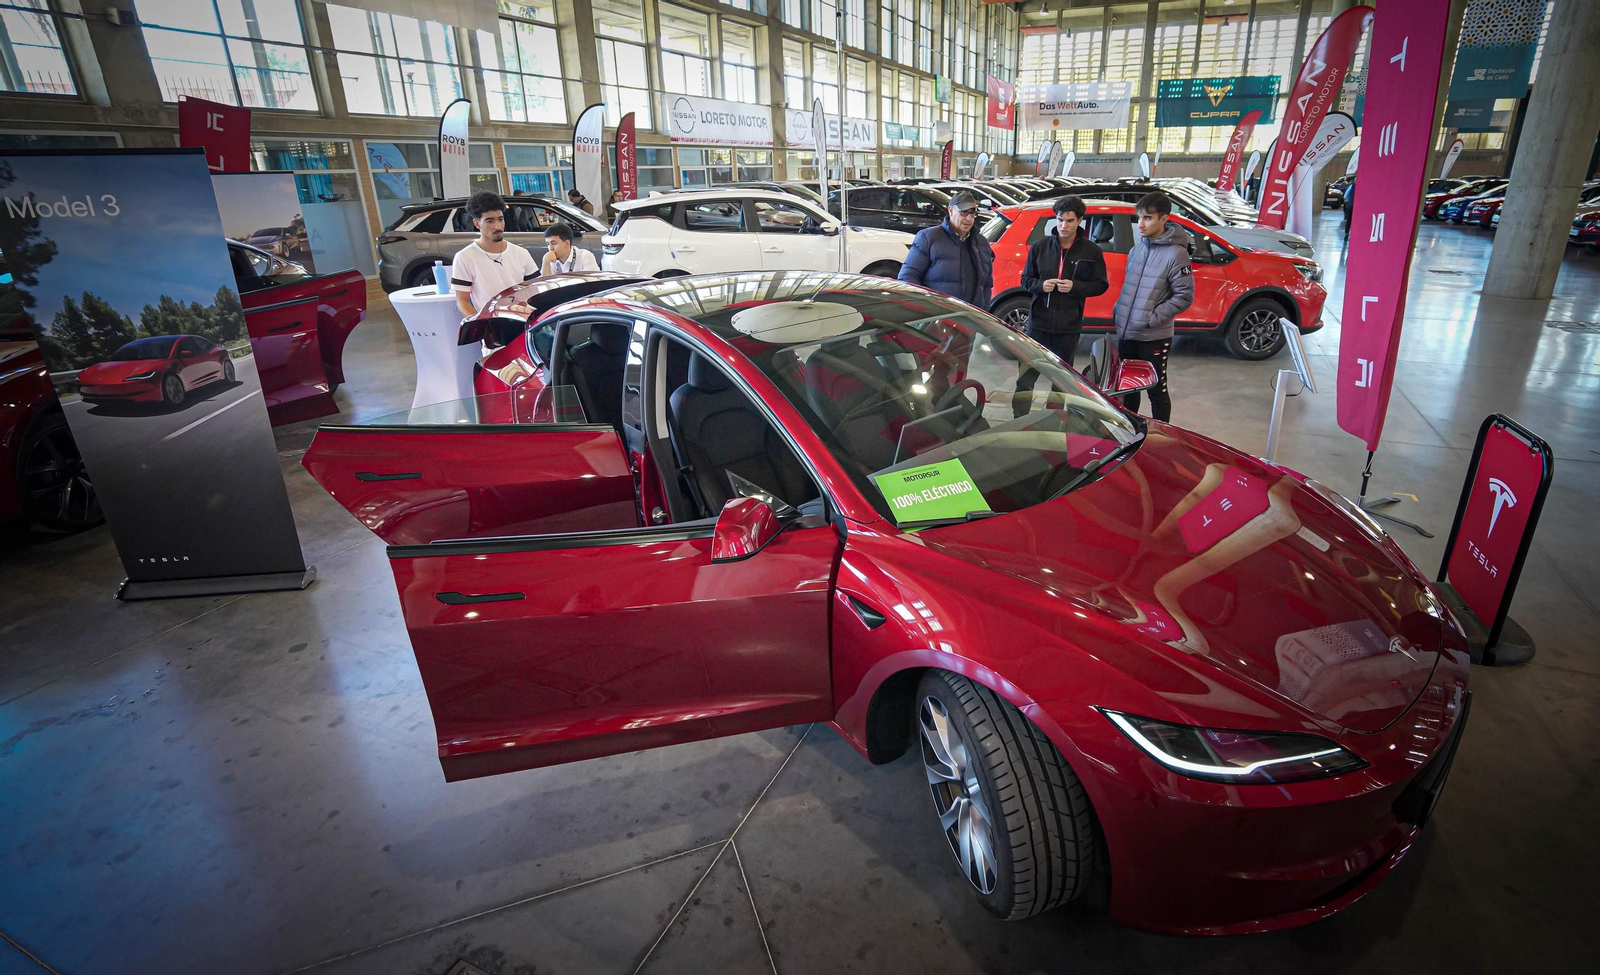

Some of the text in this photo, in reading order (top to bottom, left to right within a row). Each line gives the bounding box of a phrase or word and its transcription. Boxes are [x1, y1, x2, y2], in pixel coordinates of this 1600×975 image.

[1039, 102, 1055, 110] Das
[1297, 67, 1340, 144] LORETO MOTOR
[700, 111, 767, 128] LORETO MOTOR
[442, 134, 466, 146] ROYB
[576, 136, 600, 145] ROYB
[1267, 58, 1327, 216] NISSAN
[620, 132, 631, 201] NISSAN
[1219, 130, 1244, 190] NISSAN
[3, 194, 121, 219] Model 3
[903, 470, 940, 483] MOTORSUR
[891, 480, 973, 510] 100% ELÉCTRICO
[138, 555, 190, 564] TESLA
[1468, 540, 1498, 578] TESLA
